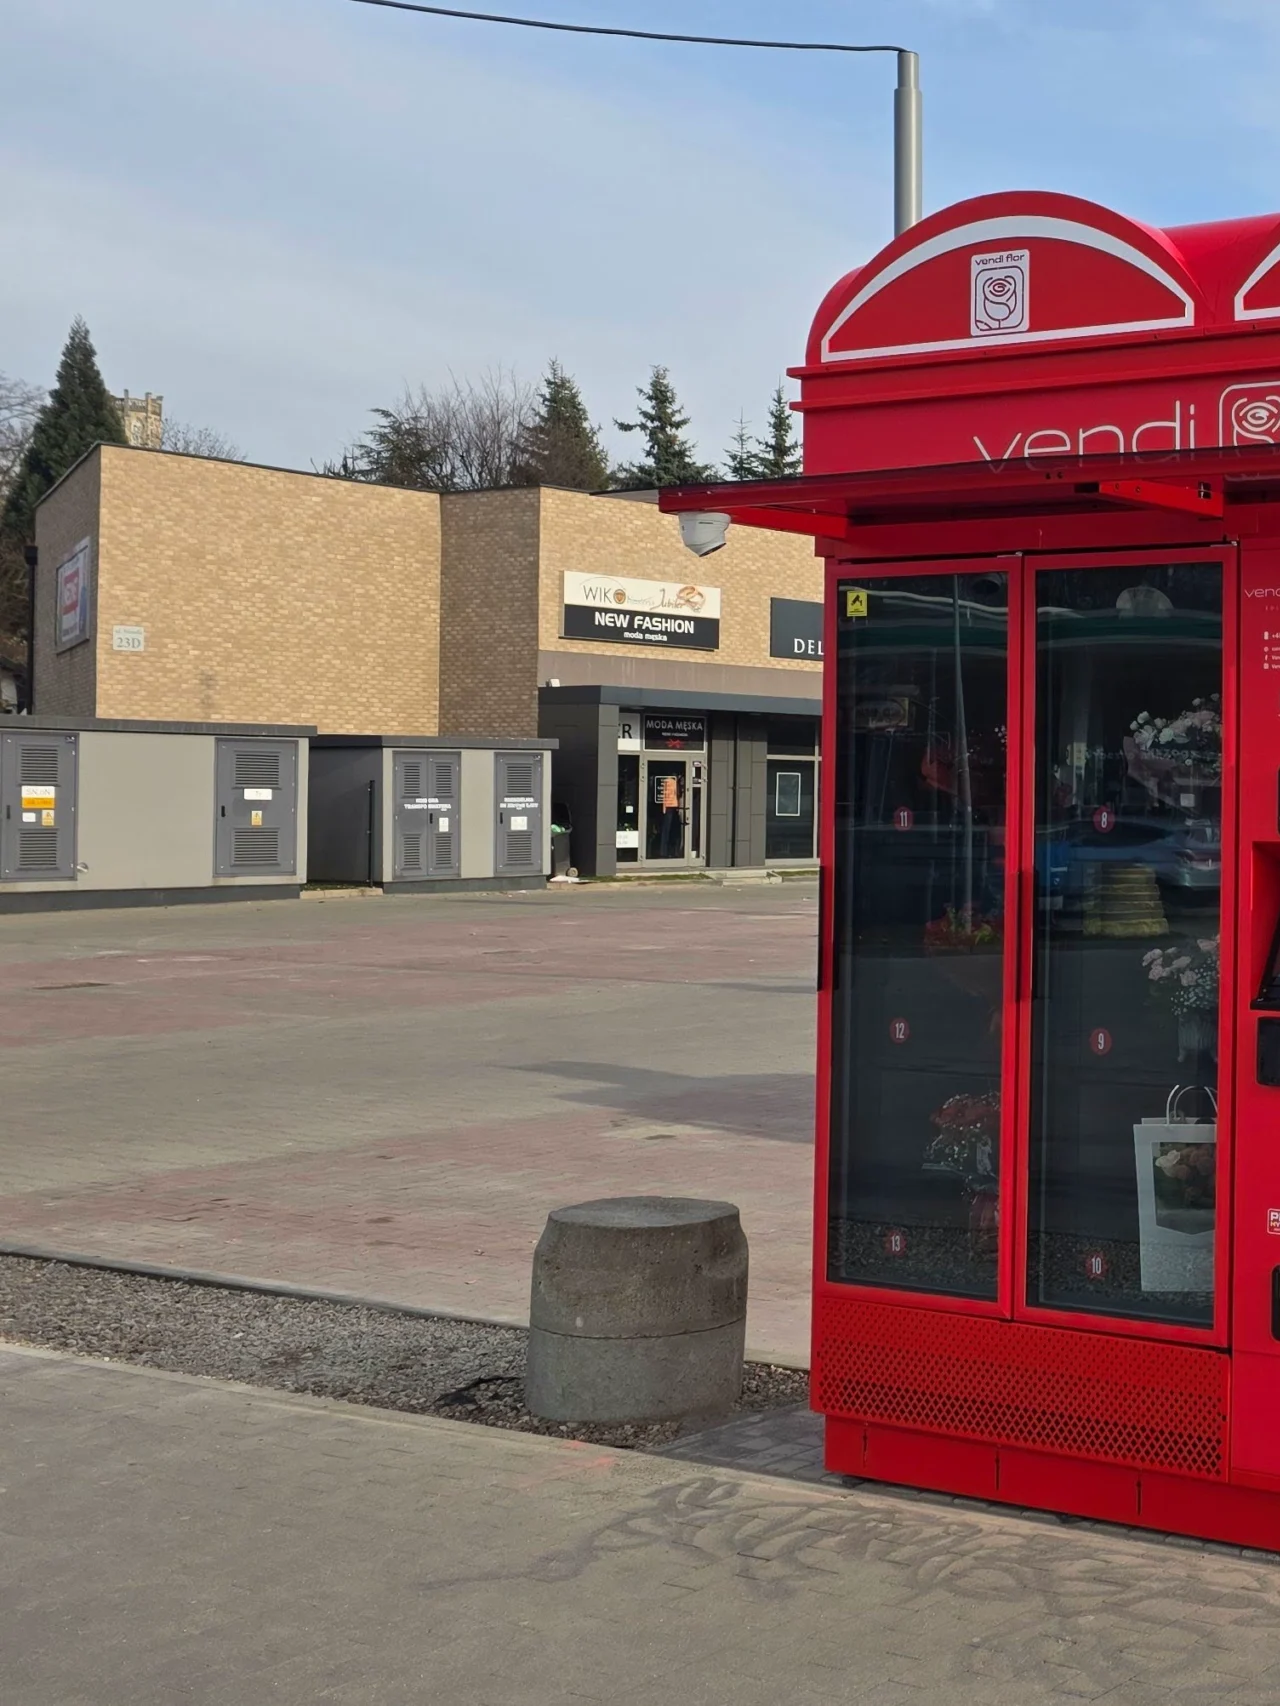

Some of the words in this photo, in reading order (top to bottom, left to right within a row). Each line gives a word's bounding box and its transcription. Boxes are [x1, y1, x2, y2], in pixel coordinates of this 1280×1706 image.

[974, 254, 1004, 266] vendi
[1005, 253, 1025, 263] flor
[973, 400, 1196, 468] vendi
[594, 611, 630, 628] NEW
[633, 615, 695, 634] FASHION
[116, 636, 141, 649] 23D
[623, 631, 644, 640] moda
[646, 719, 673, 729] MODA
[675, 721, 703, 732] MĘSKA
[899, 810, 909, 828] 11
[1100, 812, 1108, 829] 8
[894, 1022, 906, 1039] 12
[1097, 1033, 1105, 1050] 9
[890, 1235, 902, 1251] 13
[1090, 1256, 1102, 1274] 10
